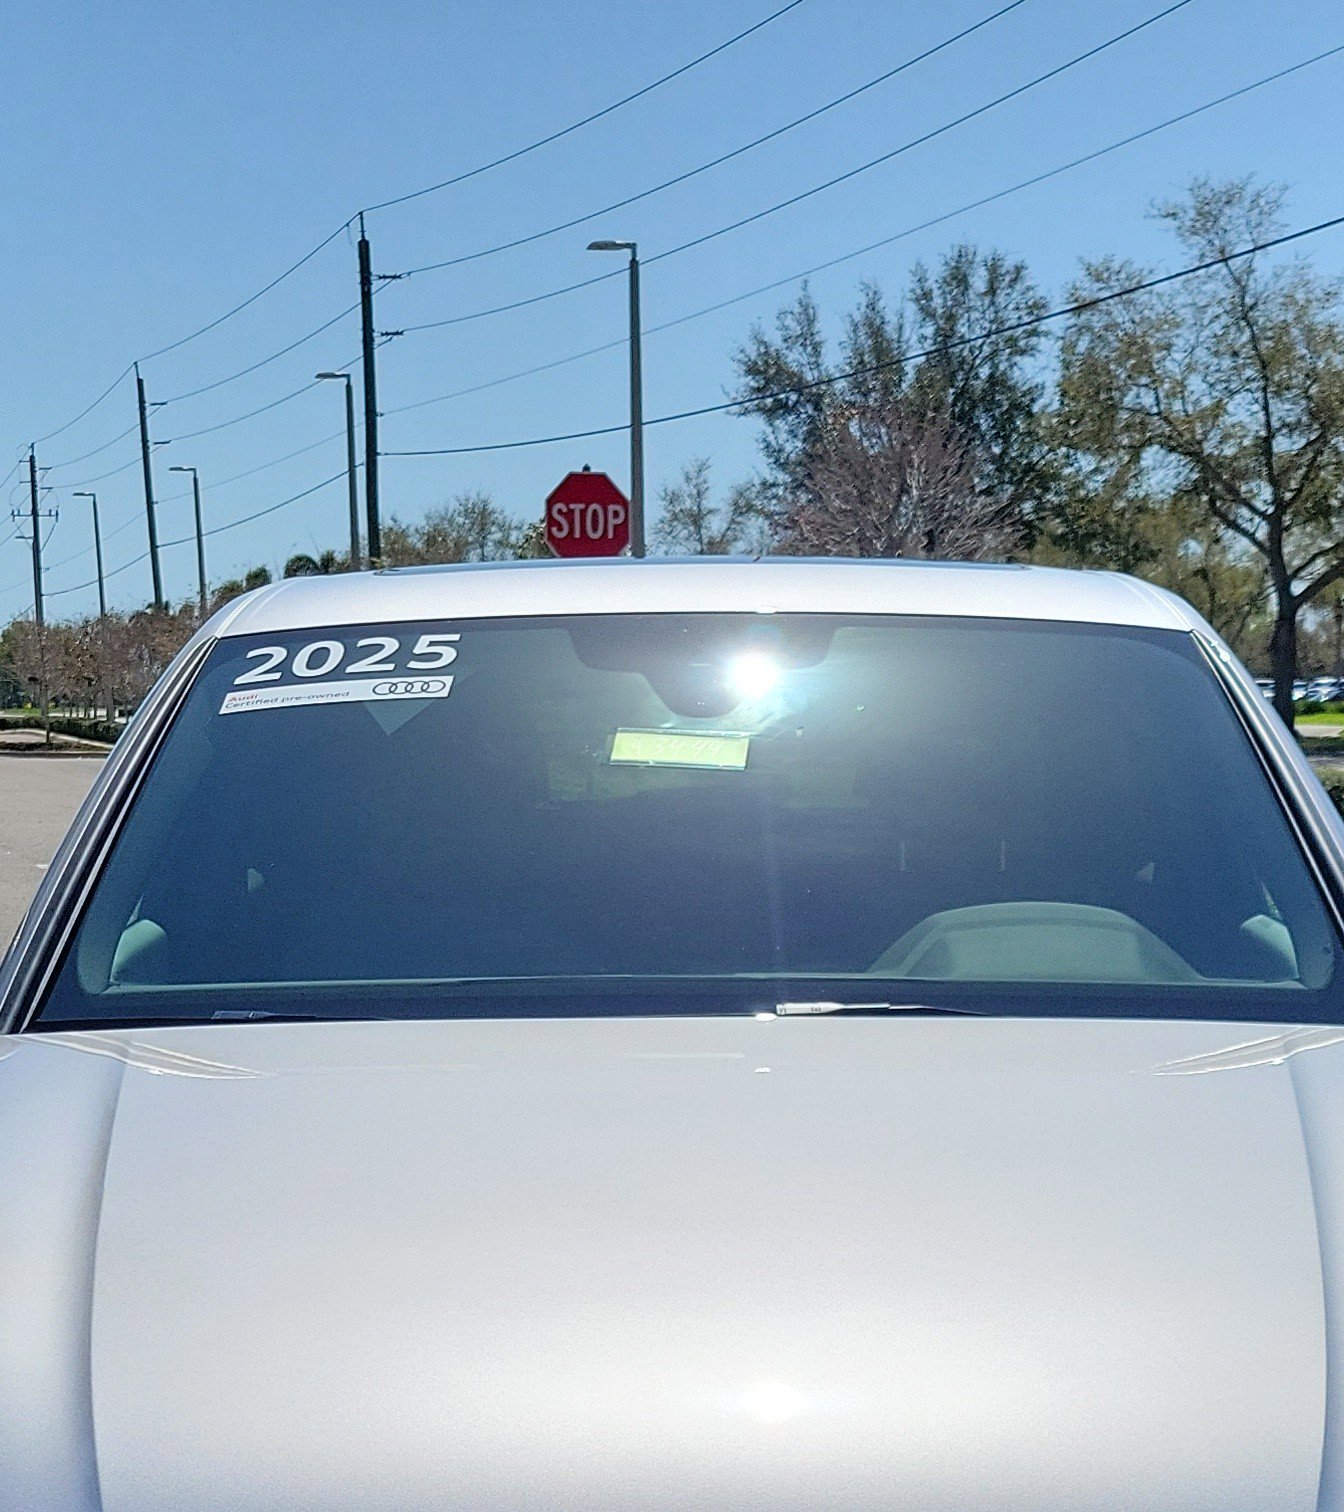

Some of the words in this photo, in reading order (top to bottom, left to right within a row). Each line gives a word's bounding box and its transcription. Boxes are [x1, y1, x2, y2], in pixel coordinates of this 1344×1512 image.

[551, 503, 626, 540] STOP
[233, 633, 461, 685] 2025
[225, 697, 278, 709] Certified
[281, 691, 350, 703] pre-owned
[227, 693, 258, 702] Audi
